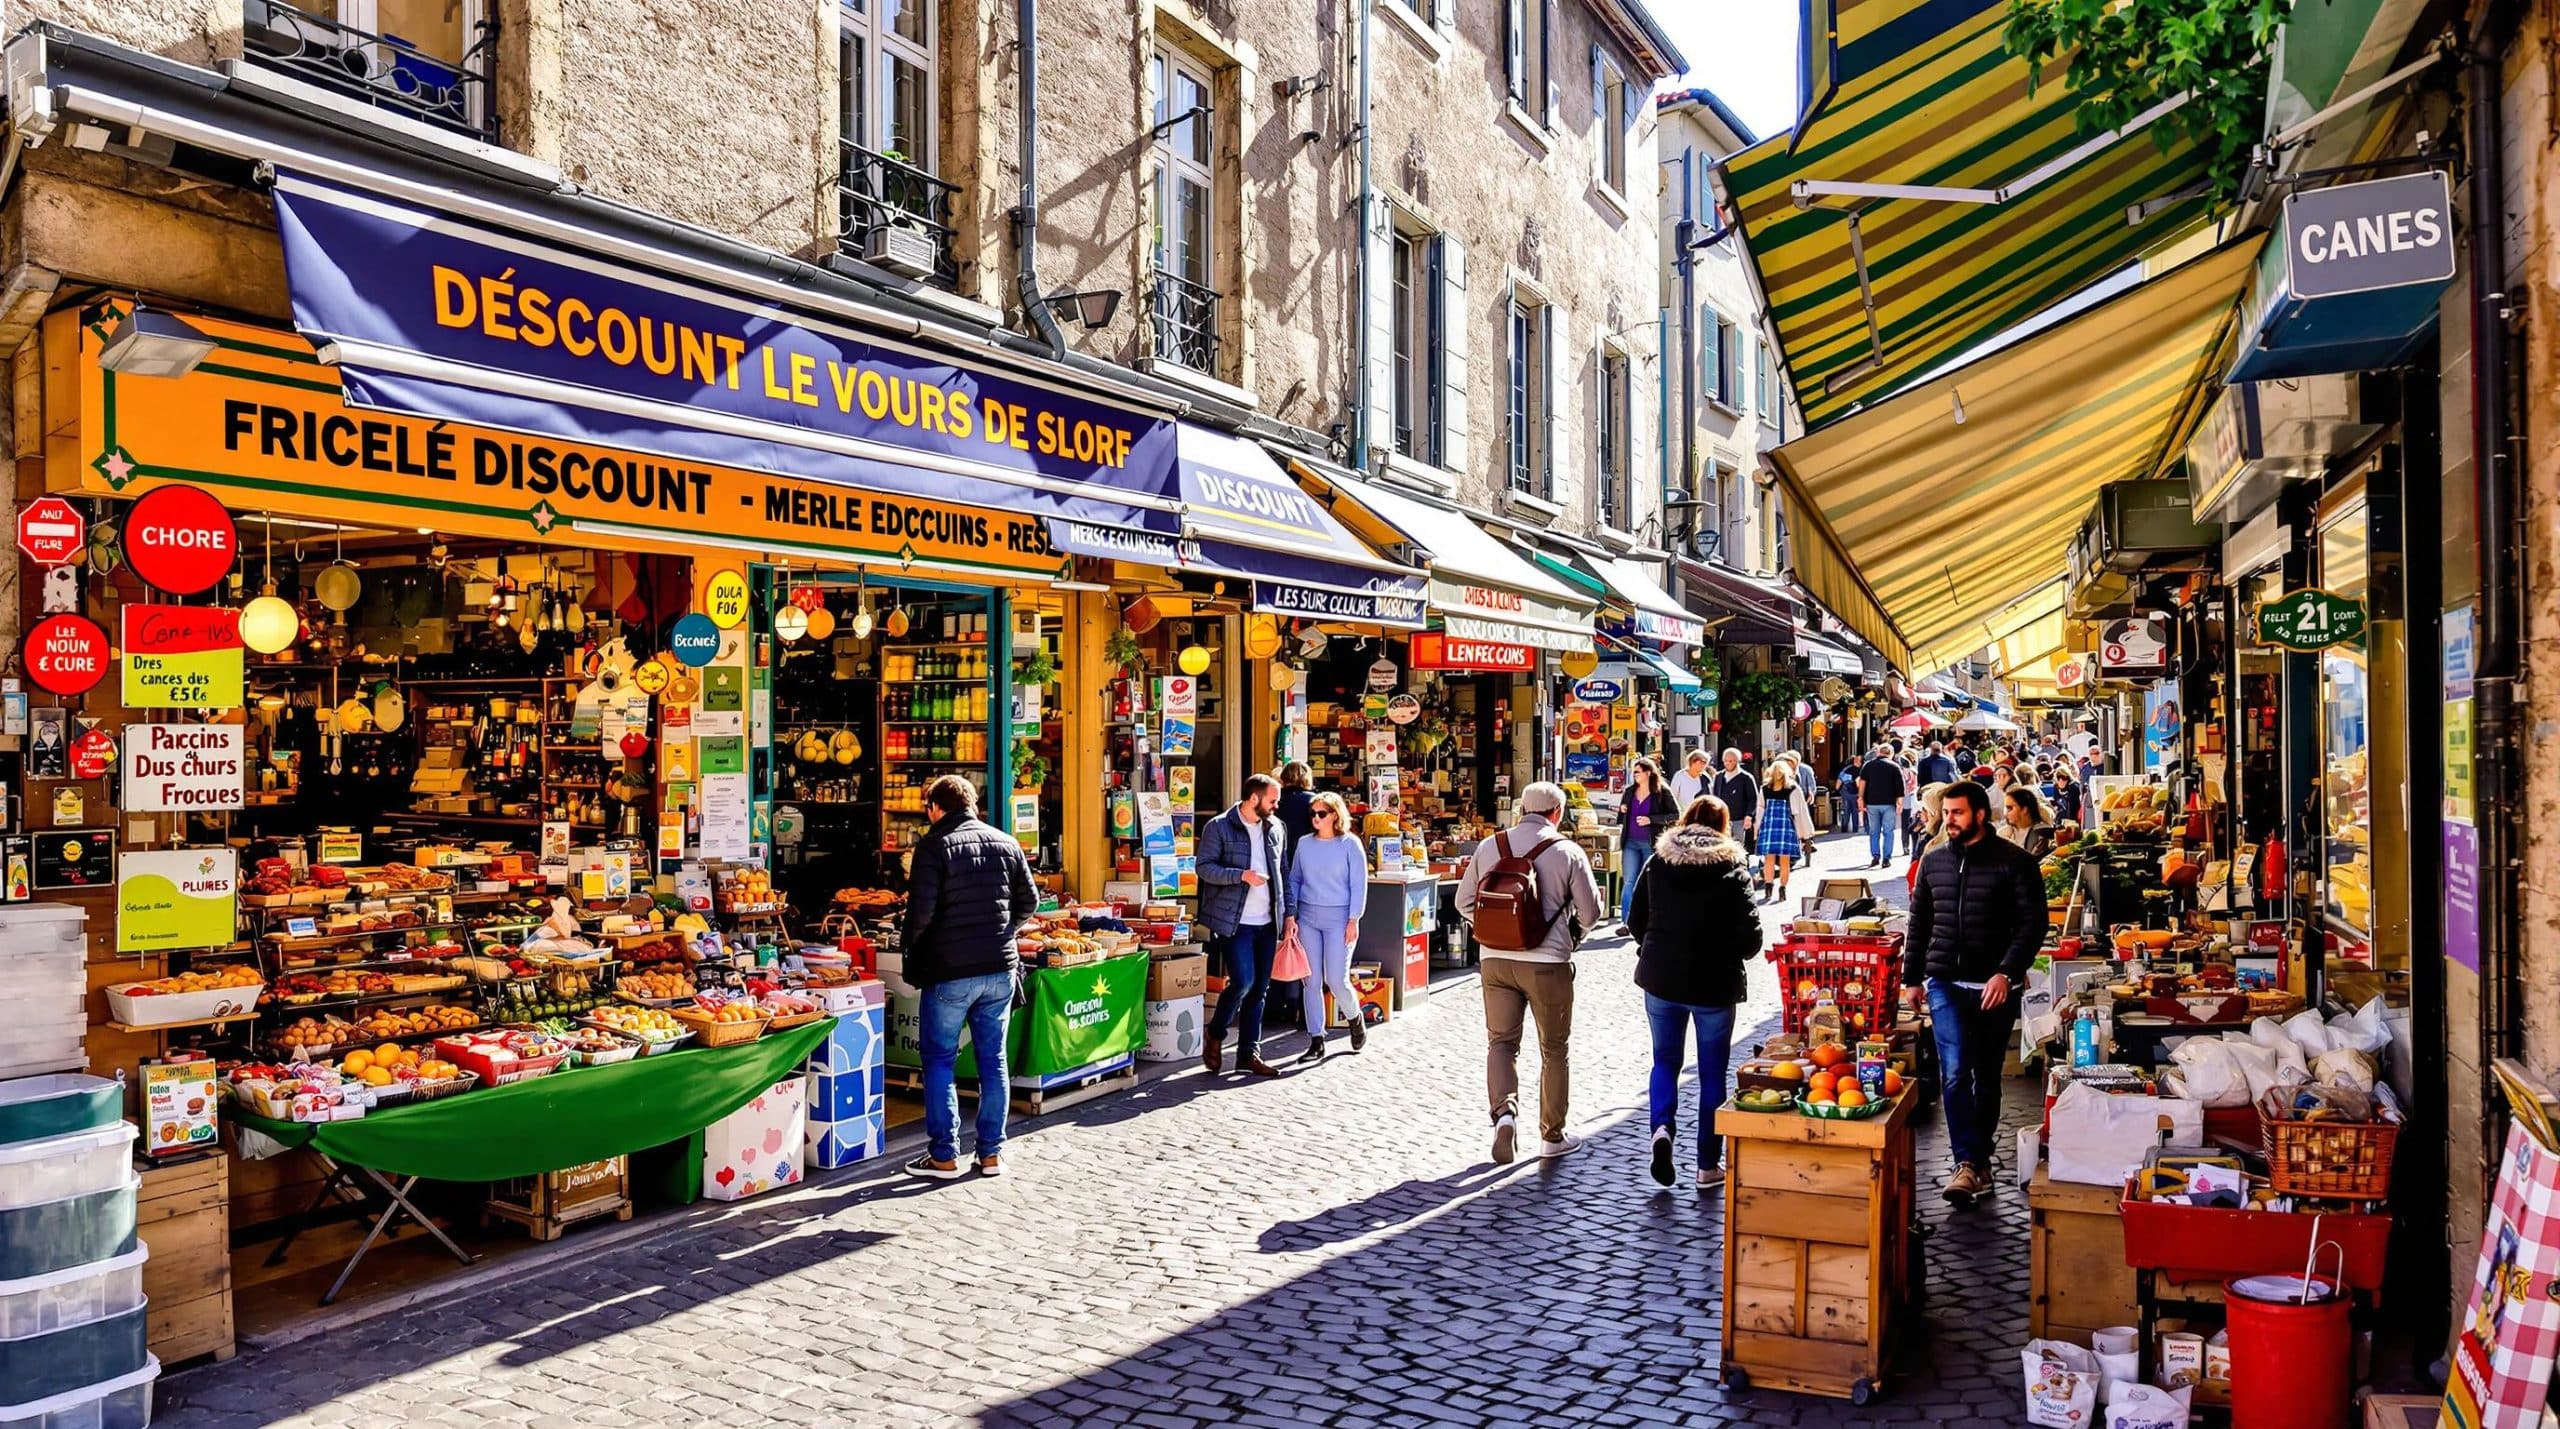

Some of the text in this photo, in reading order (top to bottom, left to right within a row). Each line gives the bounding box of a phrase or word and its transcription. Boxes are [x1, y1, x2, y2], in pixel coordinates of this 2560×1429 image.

[2300, 208, 2442, 263] CANES
[432, 265, 1132, 469] DÉSCOUNT LE VOURS DE SLORF
[224, 400, 457, 481] FRICELÉ
[473, 438, 711, 515] DISCOUNT
[1195, 471, 1313, 526] DISCOUNT
[142, 526, 227, 549] CHORE
[2297, 602, 2328, 631] 21
[46, 640, 90, 654] NOUN
[54, 656, 96, 672] CURE
[136, 754, 175, 777] Dus
[162, 783, 240, 805] Frocues
